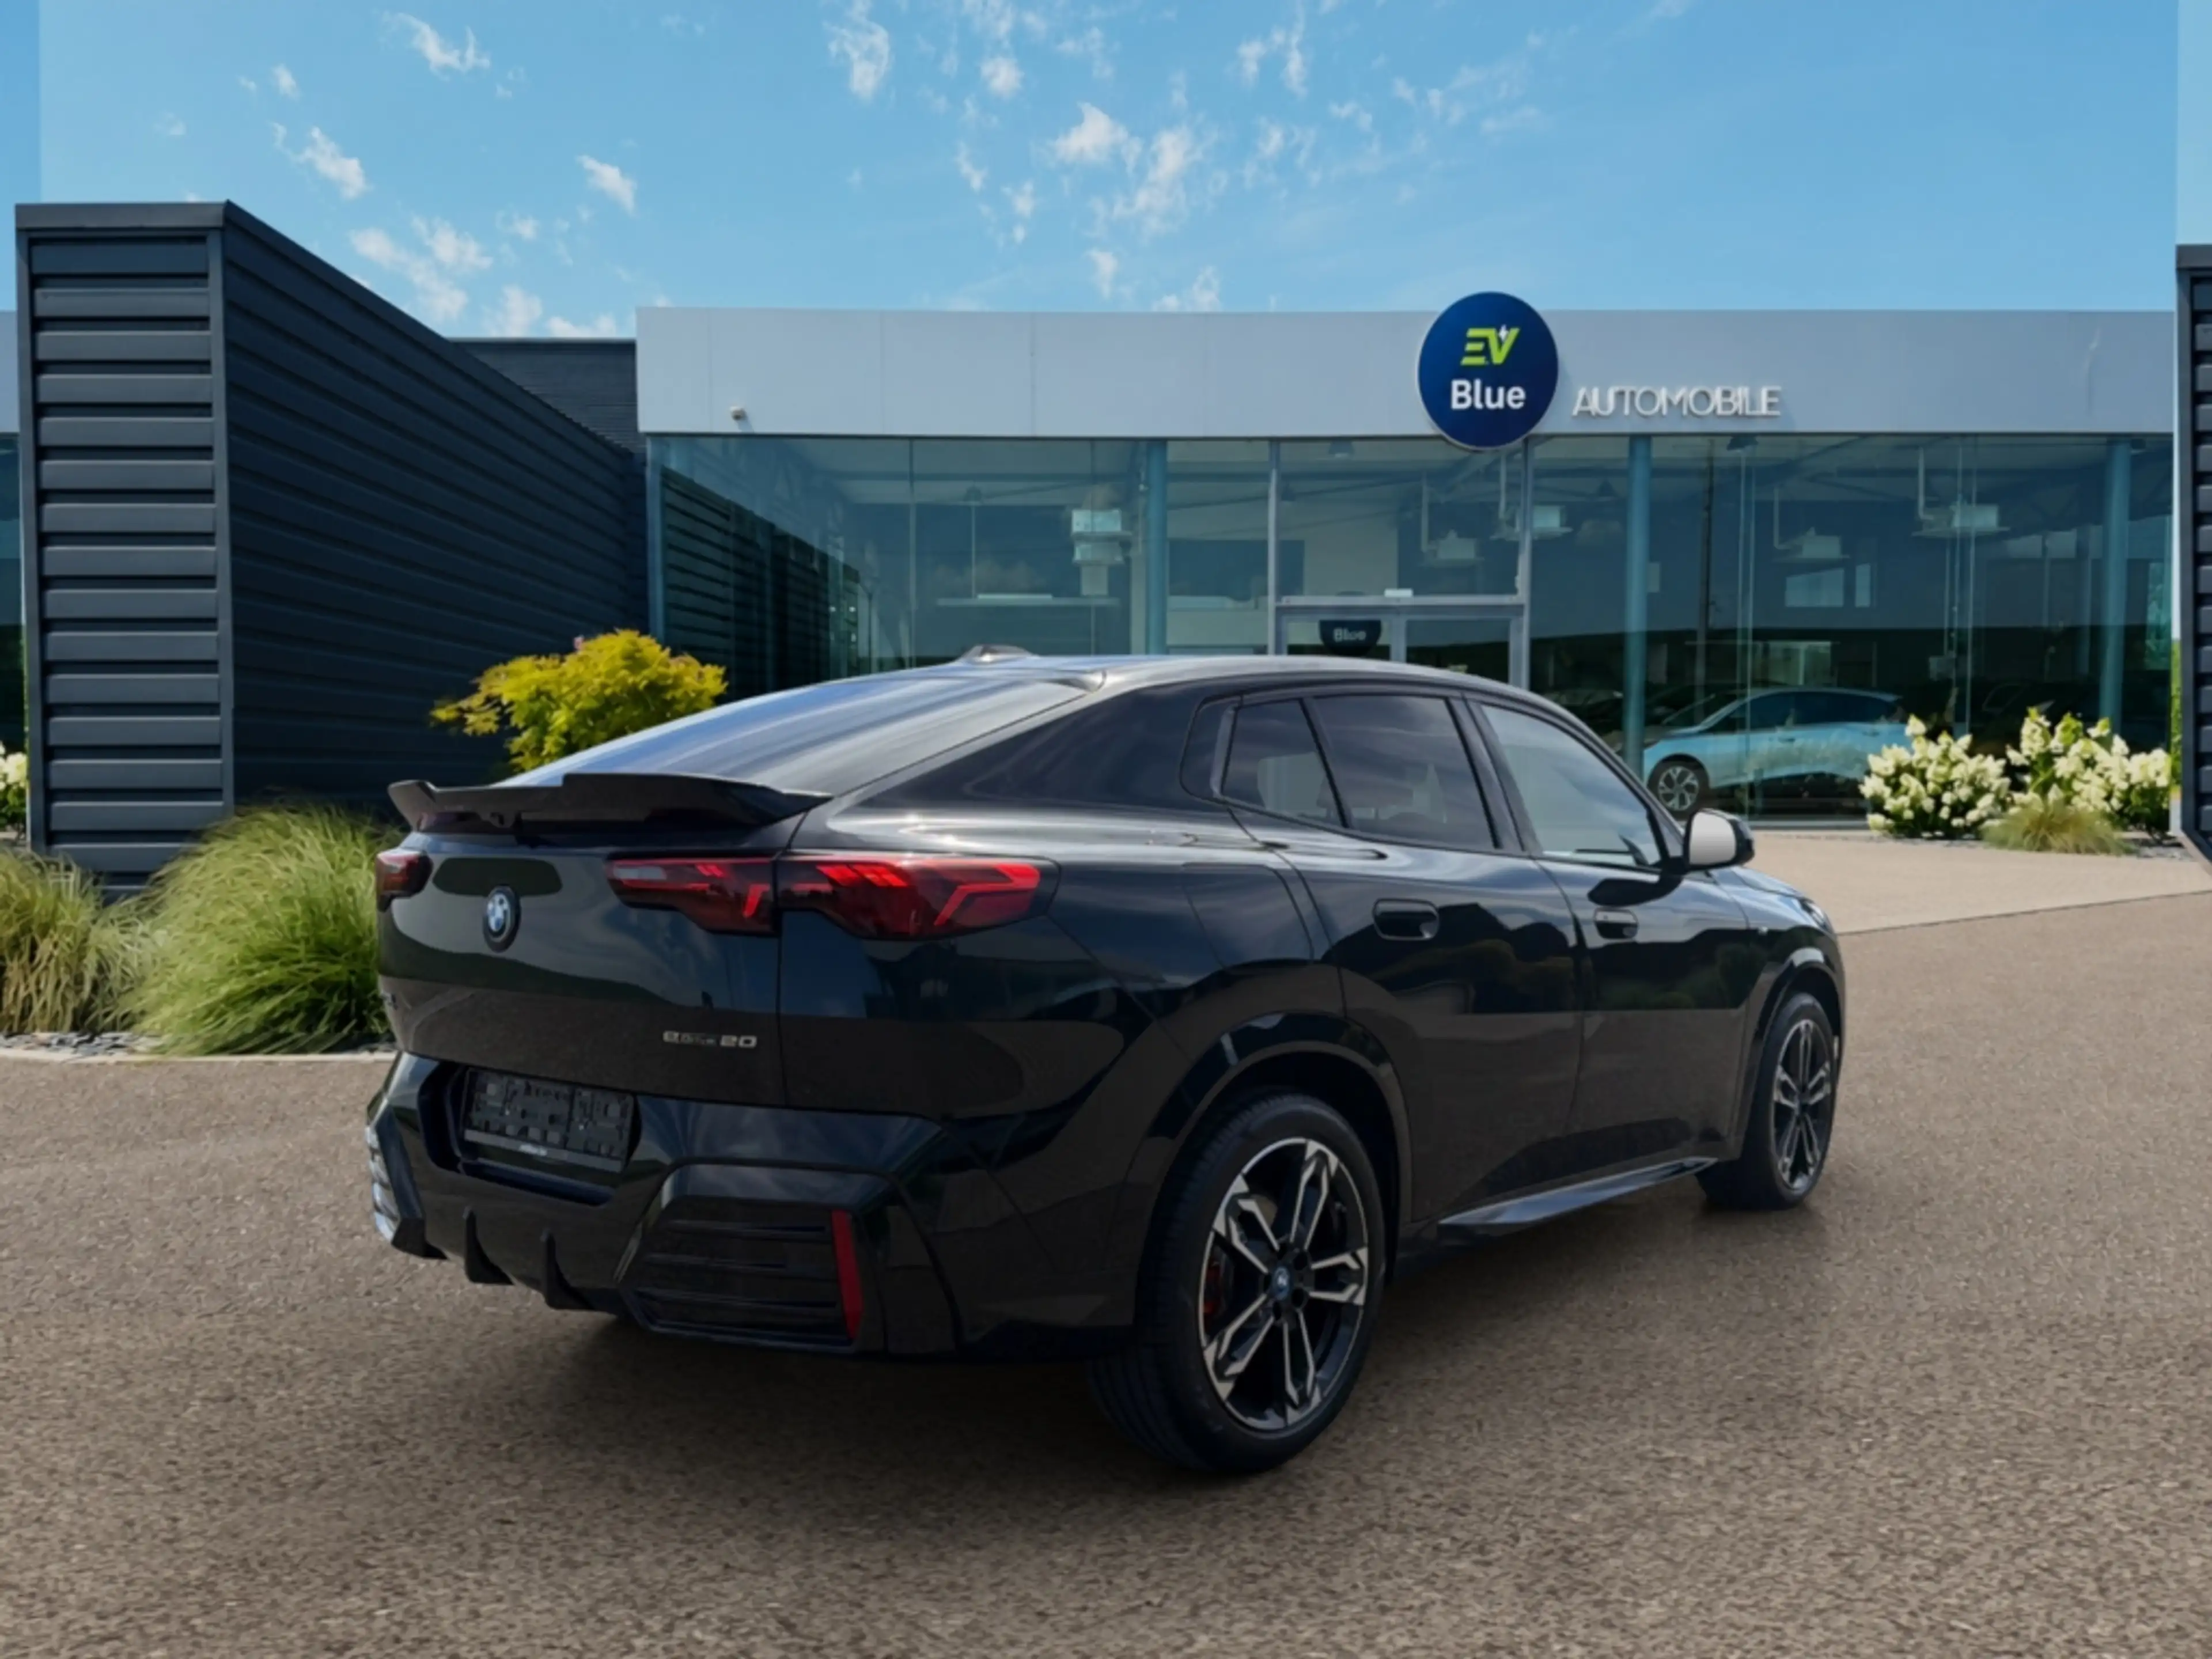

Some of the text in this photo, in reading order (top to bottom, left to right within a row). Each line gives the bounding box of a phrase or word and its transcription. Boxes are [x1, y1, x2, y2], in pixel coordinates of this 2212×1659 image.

[1460, 328, 1520, 365] EV
[1450, 379, 1527, 410] Blue
[1572, 386, 1782, 416] AUTOMOBILE
